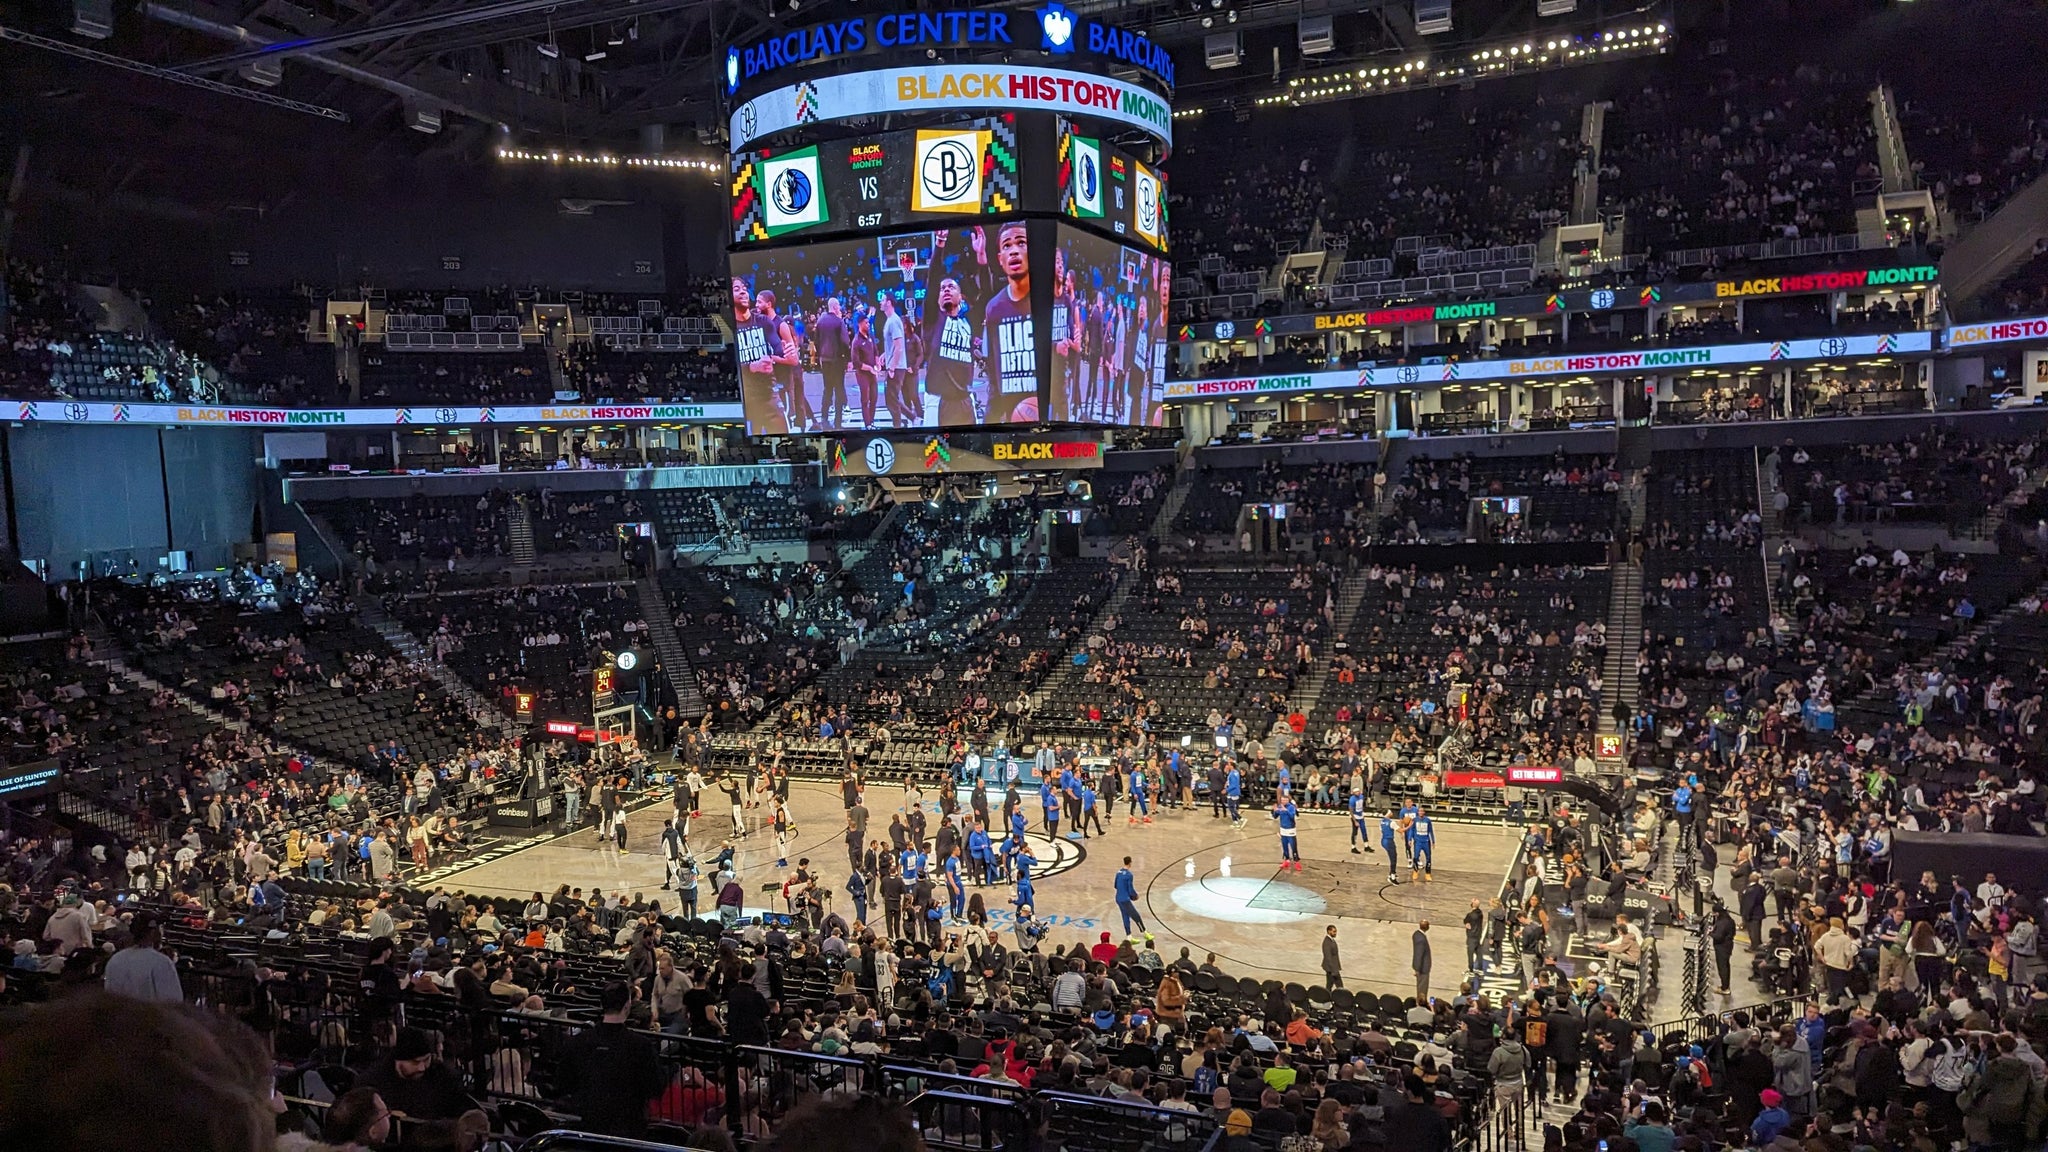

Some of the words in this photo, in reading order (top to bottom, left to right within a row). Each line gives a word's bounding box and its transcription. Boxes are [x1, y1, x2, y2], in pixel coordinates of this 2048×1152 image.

[745, 19, 866, 78] BARCLAYS
[876, 12, 1013, 47] CENTER
[1089, 22, 1171, 83] BARCLAYS
[897, 74, 1006, 100] BLACK
[1009, 74, 1121, 110] HISTORY
[1123, 91, 1169, 130] MONTH
[849, 152, 884, 163] HISTORY
[853, 145, 880, 156] BLACK
[853, 160, 883, 169] MONTH
[859, 177, 878, 200] VS
[858, 213, 882, 227] 6:57
[443, 262, 460, 270] 203
[635, 265, 651, 273] 204
[1716, 278, 1781, 297] BLACK
[1782, 271, 1867, 291] HISTORY
[1315, 313, 1366, 329] BLACK
[1367, 307, 1435, 326] HISTORY
[1435, 302, 1496, 319] MONTH
[1510, 359, 1565, 374] BLACK
[1568, 354, 1643, 370] HISTORY
[1644, 349, 1711, 365] MONTH
[1197, 379, 1257, 394] HISTORY
[1258, 376, 1312, 390] MONTH
[178, 408, 227, 421] BLACK
[228, 410, 286, 422] HISTORY
[288, 411, 345, 423] MONTH
[541, 408, 590, 419] BLACK
[591, 408, 652, 419] HISTORY
[653, 406, 704, 418] MONTH
[994, 443, 1053, 459] BLACK
[25, 769, 57, 781] SUNTORY
[498, 808, 529, 818] coinbase
[1587, 894, 1648, 909] coase
[877, 965, 885, 976] 33
